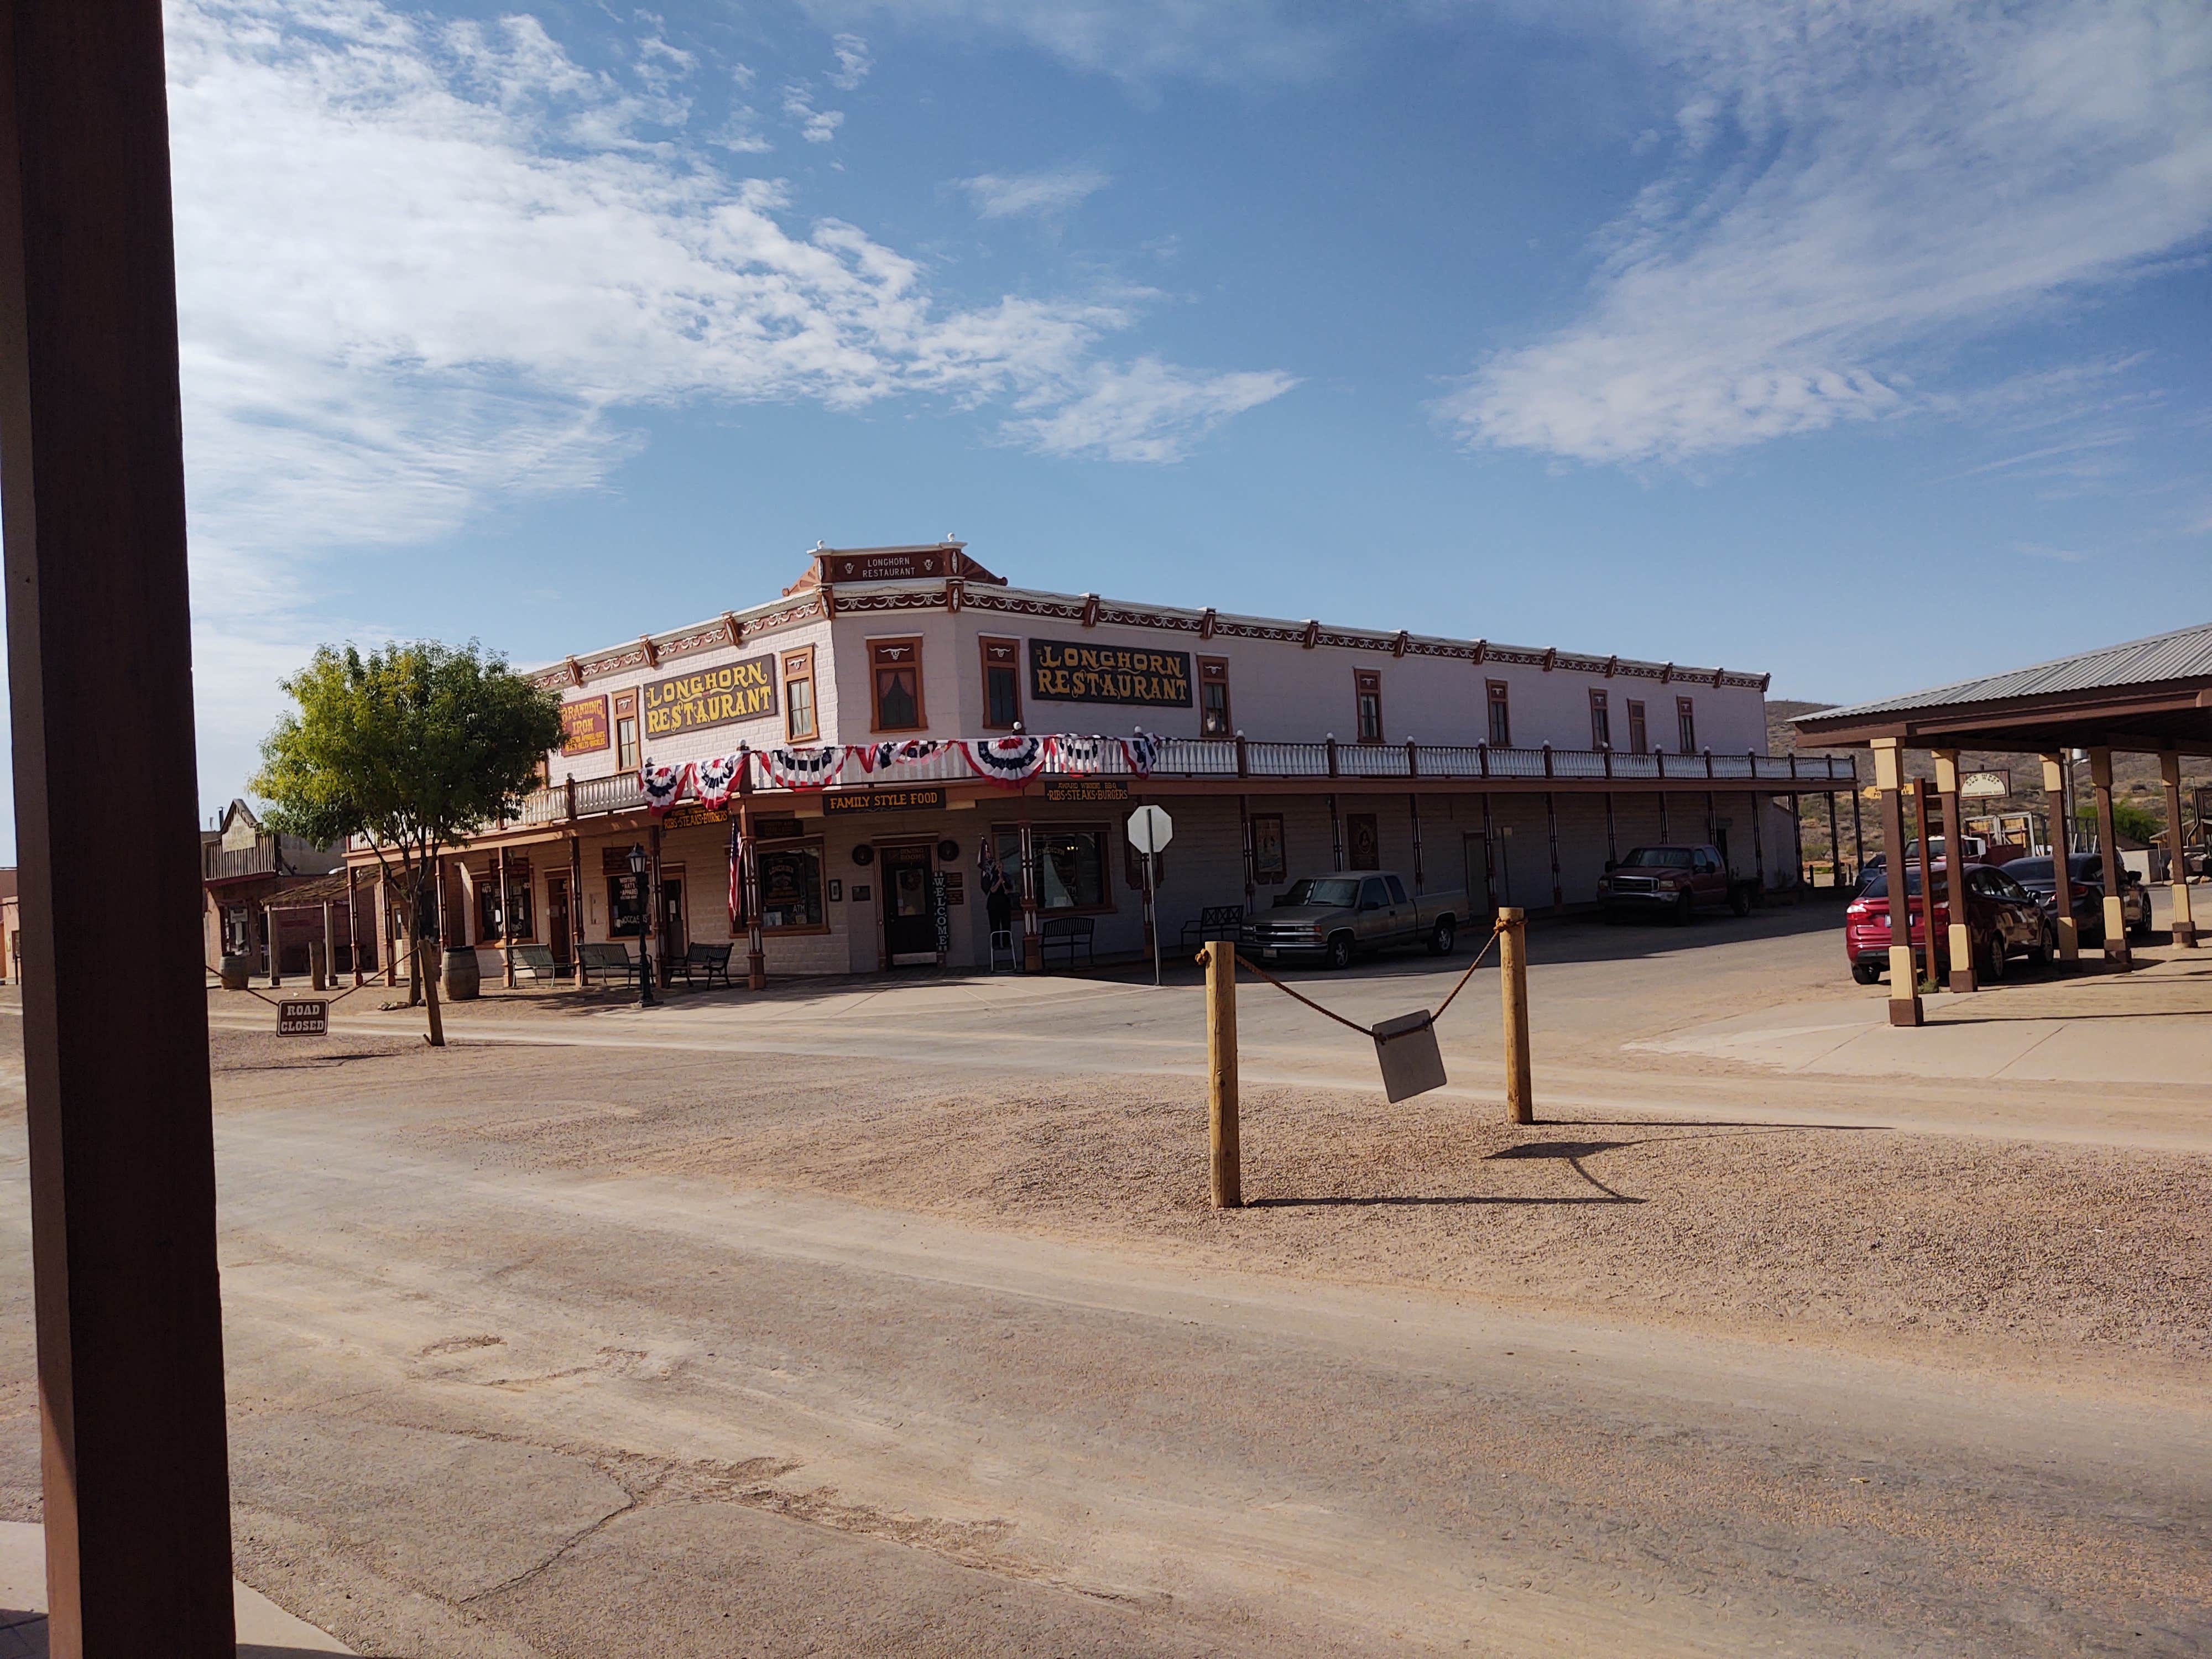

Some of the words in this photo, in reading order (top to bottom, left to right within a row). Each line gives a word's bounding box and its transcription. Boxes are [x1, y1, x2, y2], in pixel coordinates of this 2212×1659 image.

[868, 557, 910, 567] LONGHORN
[863, 567, 915, 577] RESTAURANT
[1040, 646, 1184, 677] LONGHORN
[648, 661, 768, 708] LONGHORN
[1037, 670, 1187, 700] RESTAURANT
[561, 699, 605, 723] BRANDING
[648, 686, 771, 733] RESTAURANT
[572, 717, 594, 735] IRON
[1966, 775, 1978, 786] OLD
[830, 796, 870, 810] FAMILY
[874, 794, 907, 806] STYLE
[910, 792, 937, 805] FOOD
[792, 904, 806, 913] ATM
[933, 877, 948, 945] WELCOME
[287, 1004, 320, 1016] ROAD
[281, 1020, 324, 1032] CLOSED
